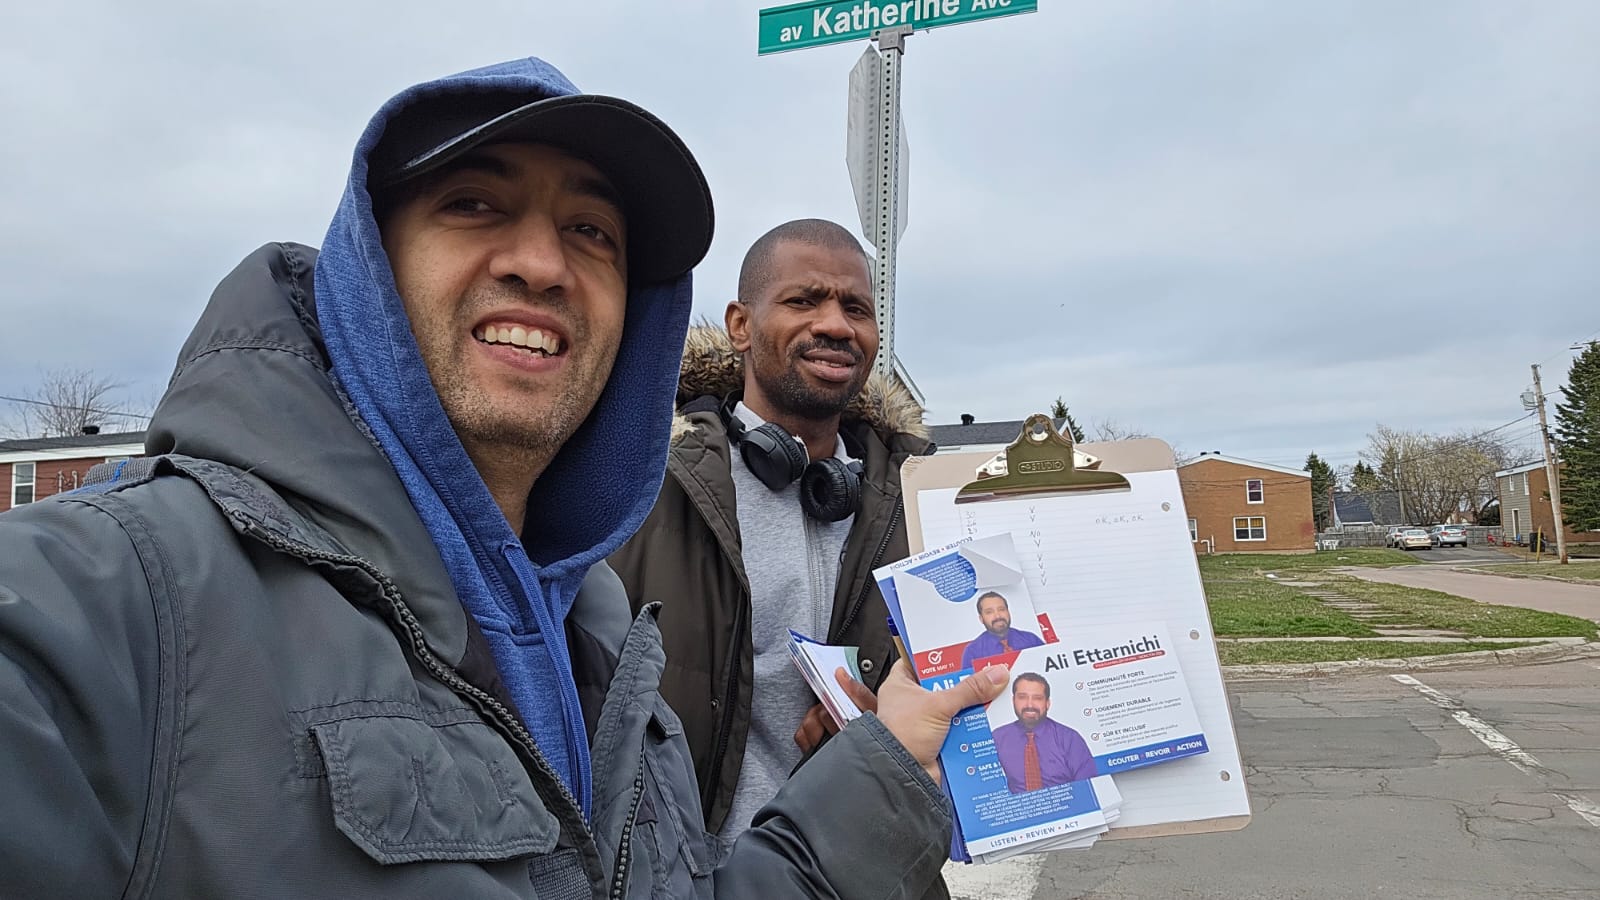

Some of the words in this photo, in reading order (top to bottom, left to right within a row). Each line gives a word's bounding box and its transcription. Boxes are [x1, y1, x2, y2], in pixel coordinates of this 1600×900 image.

[781, 25, 803, 42] av
[813, 0, 960, 37] Katherine
[1045, 653, 1069, 673] Ali
[1073, 635, 1161, 666] Ettarnichi
[921, 667, 937, 675] VOTE
[1127, 670, 1145, 679] FORTE
[1094, 702, 1126, 713] LOGEMENT
[1126, 697, 1152, 707] DURABLE
[964, 712, 987, 722] STRONG
[971, 738, 995, 749] SUSTAIN
[1107, 754, 1140, 767] ÉCOUTER
[1145, 747, 1171, 758] REVOIR
[1176, 740, 1203, 752] ACTION
[990, 836, 1017, 848] LISTEN
[1025, 826, 1055, 839] REVIEW
[1064, 820, 1079, 830] ACT
